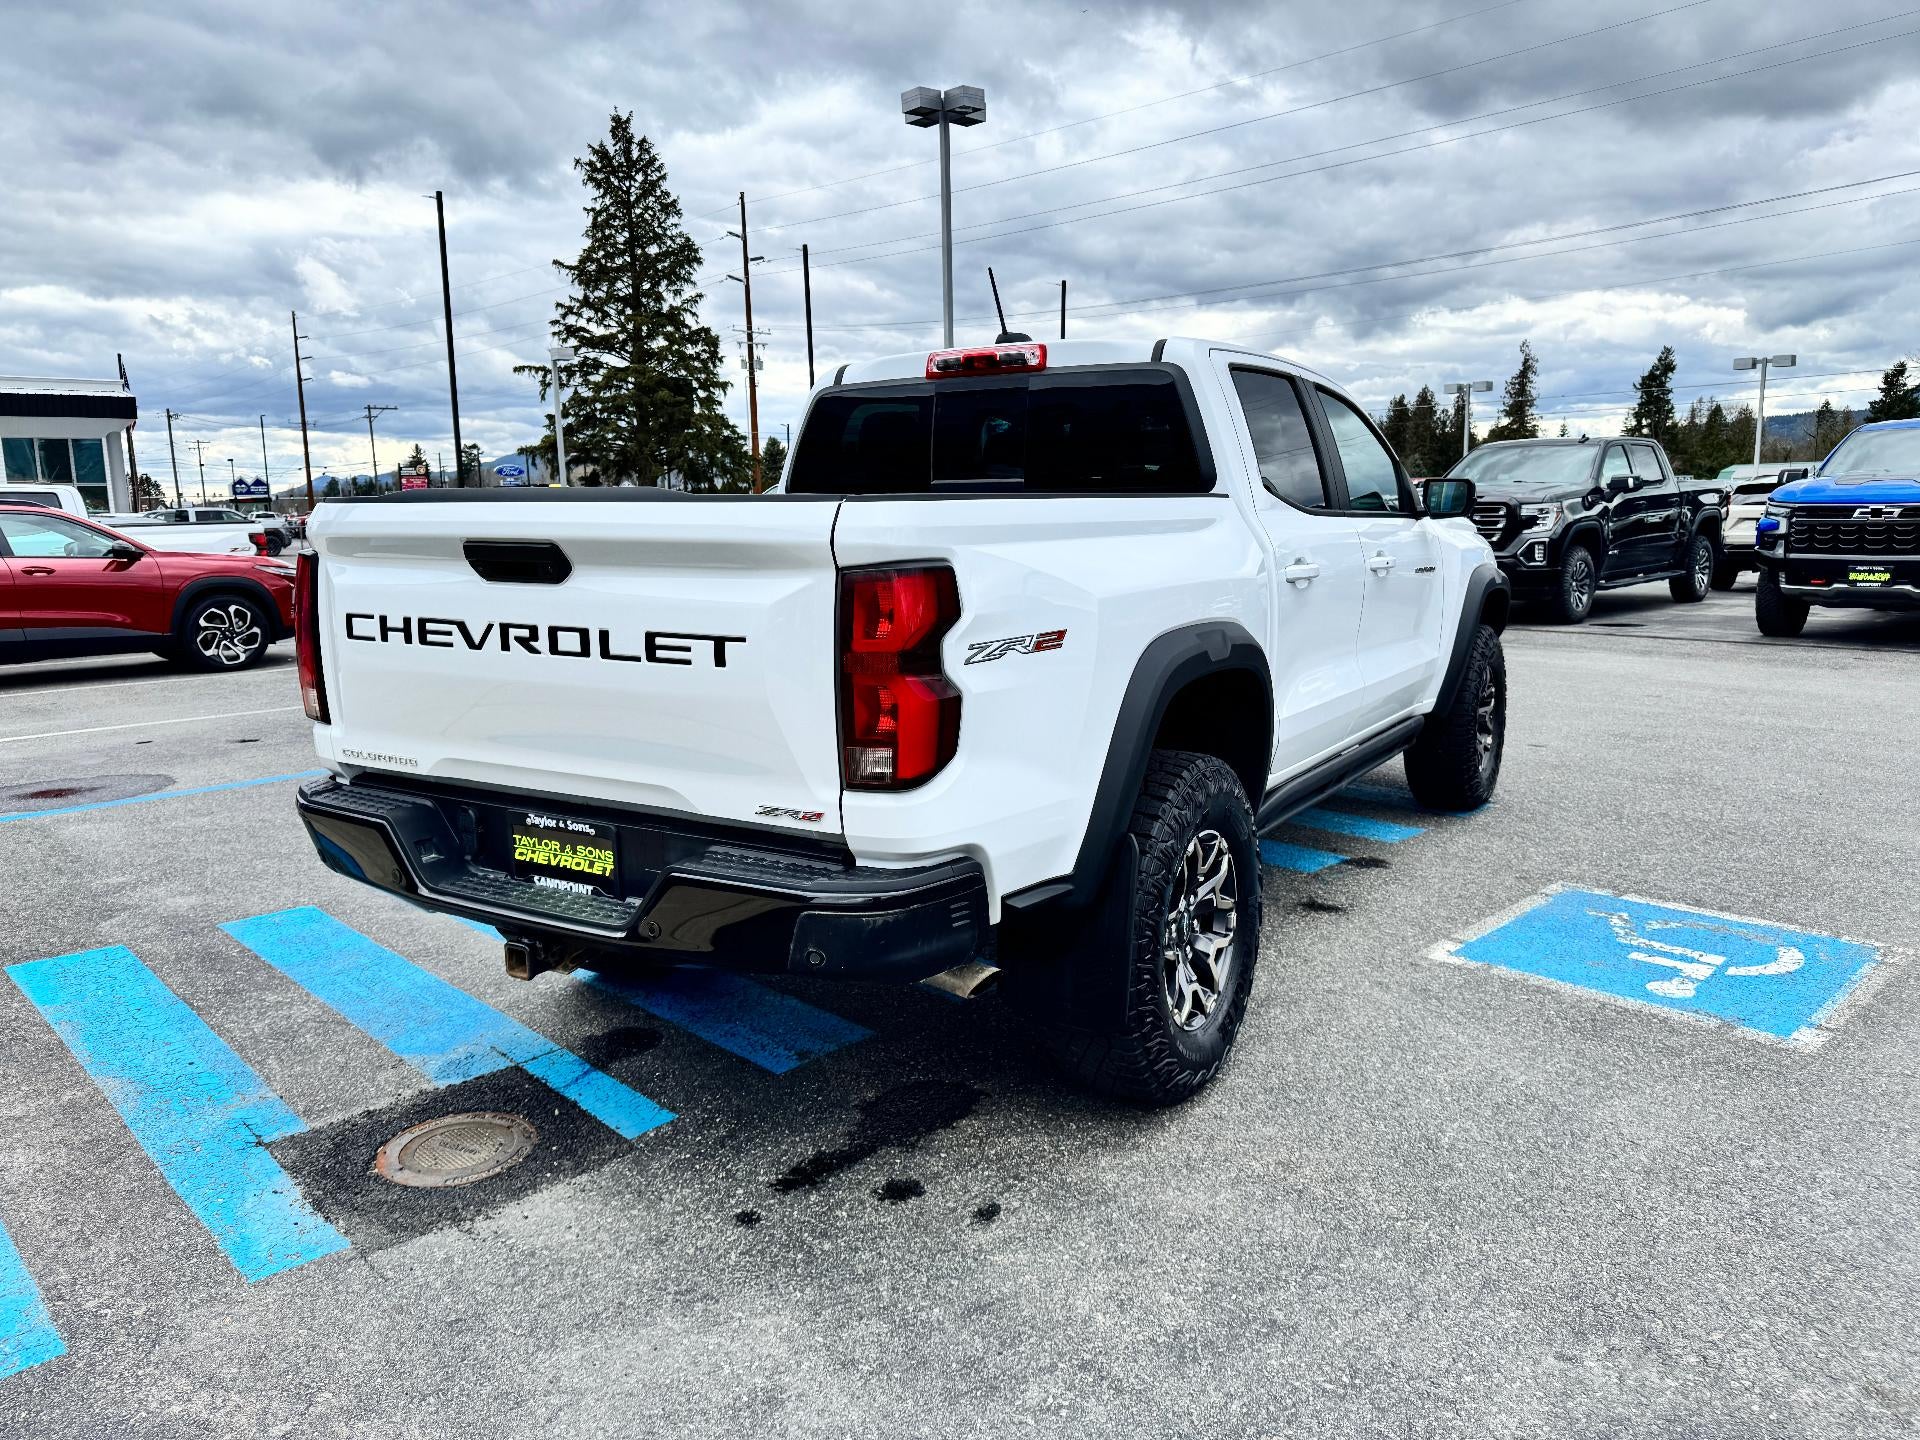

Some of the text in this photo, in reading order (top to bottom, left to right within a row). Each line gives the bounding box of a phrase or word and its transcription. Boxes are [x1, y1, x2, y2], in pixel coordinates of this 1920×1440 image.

[502, 467, 520, 475] Ford
[345, 612, 747, 668] CHEVROLET
[963, 628, 1068, 666] ZR2
[342, 749, 418, 767] COLORADO
[527, 813, 590, 832] Taylor & Sons
[754, 805, 825, 822] ZR2
[513, 834, 614, 861] TAYLOR & SONS
[514, 847, 615, 877] CHEVROLET
[533, 875, 594, 896] SANDPOINT
